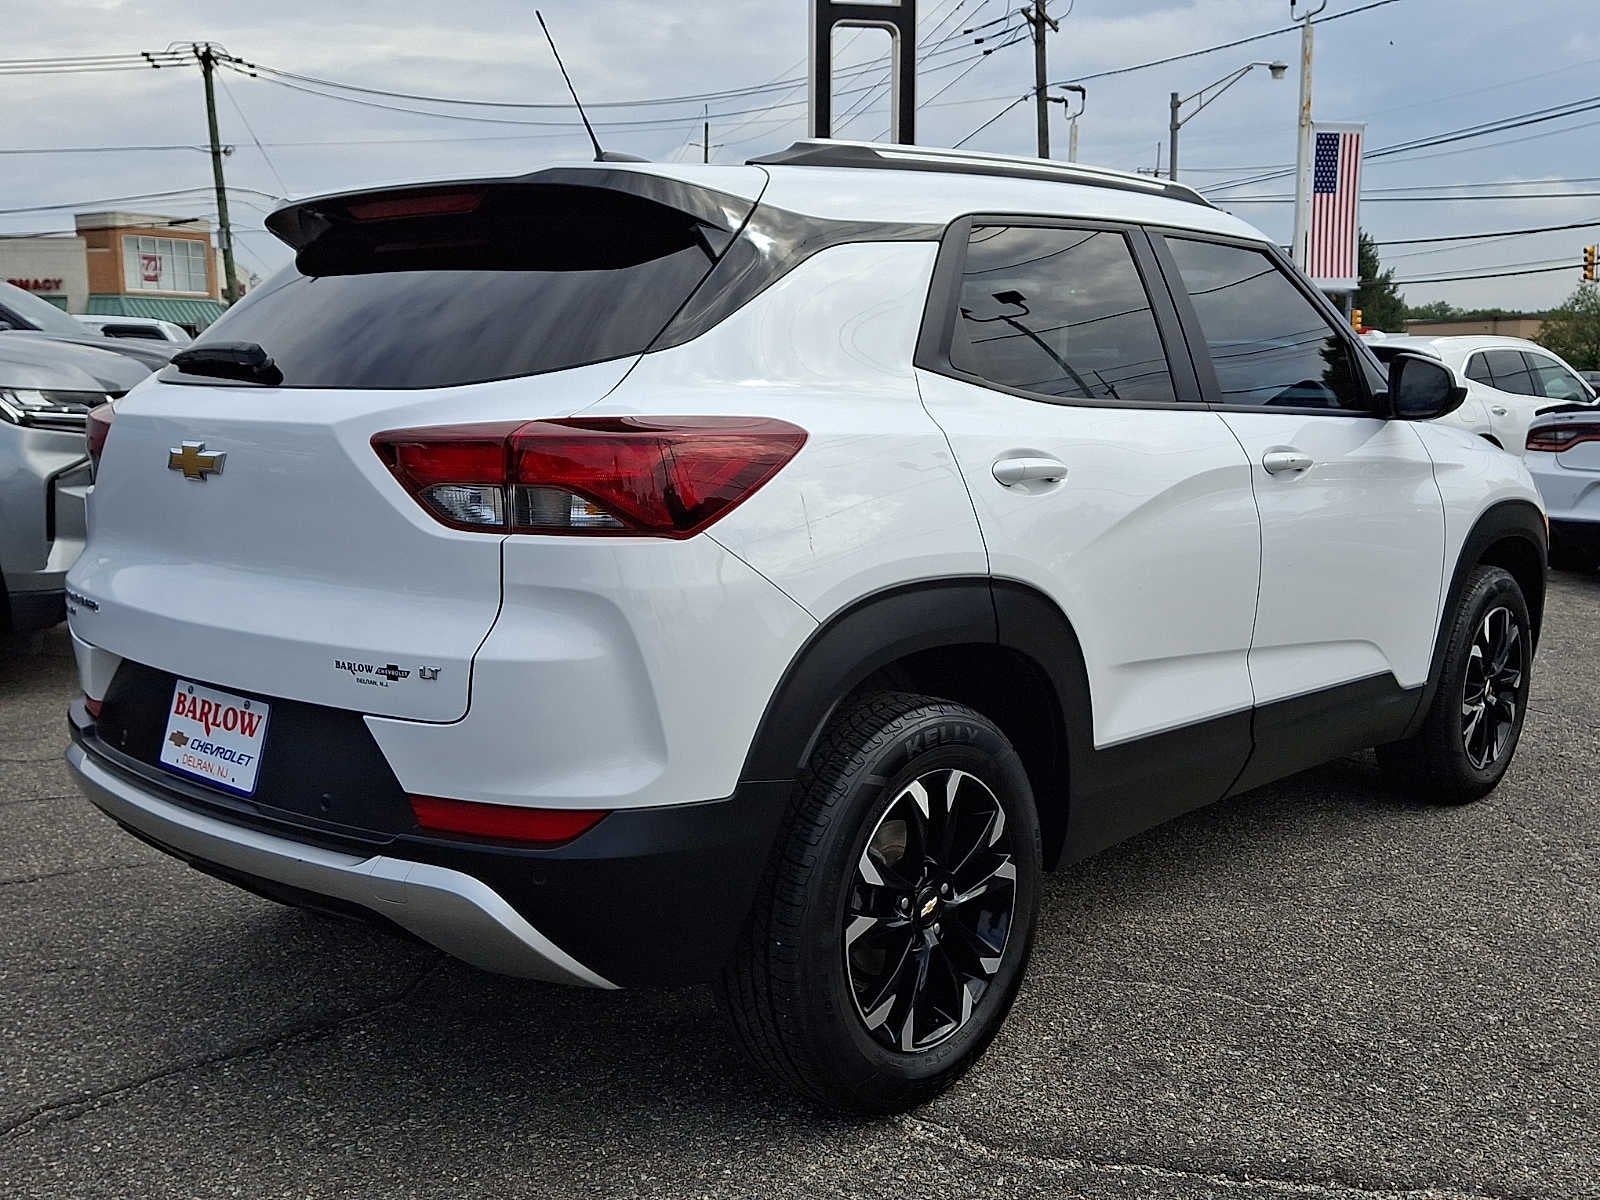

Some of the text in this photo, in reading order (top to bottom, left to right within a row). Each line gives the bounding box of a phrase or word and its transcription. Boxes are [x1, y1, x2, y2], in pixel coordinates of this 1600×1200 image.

[335, 660, 411, 679] BARLOW CHEVROLET
[419, 666, 441, 681] LT
[174, 691, 262, 738] BARLOW
[904, 723, 979, 754] KELLY
[190, 738, 254, 767] CHEVROLET
[217, 766, 229, 779] NJ
